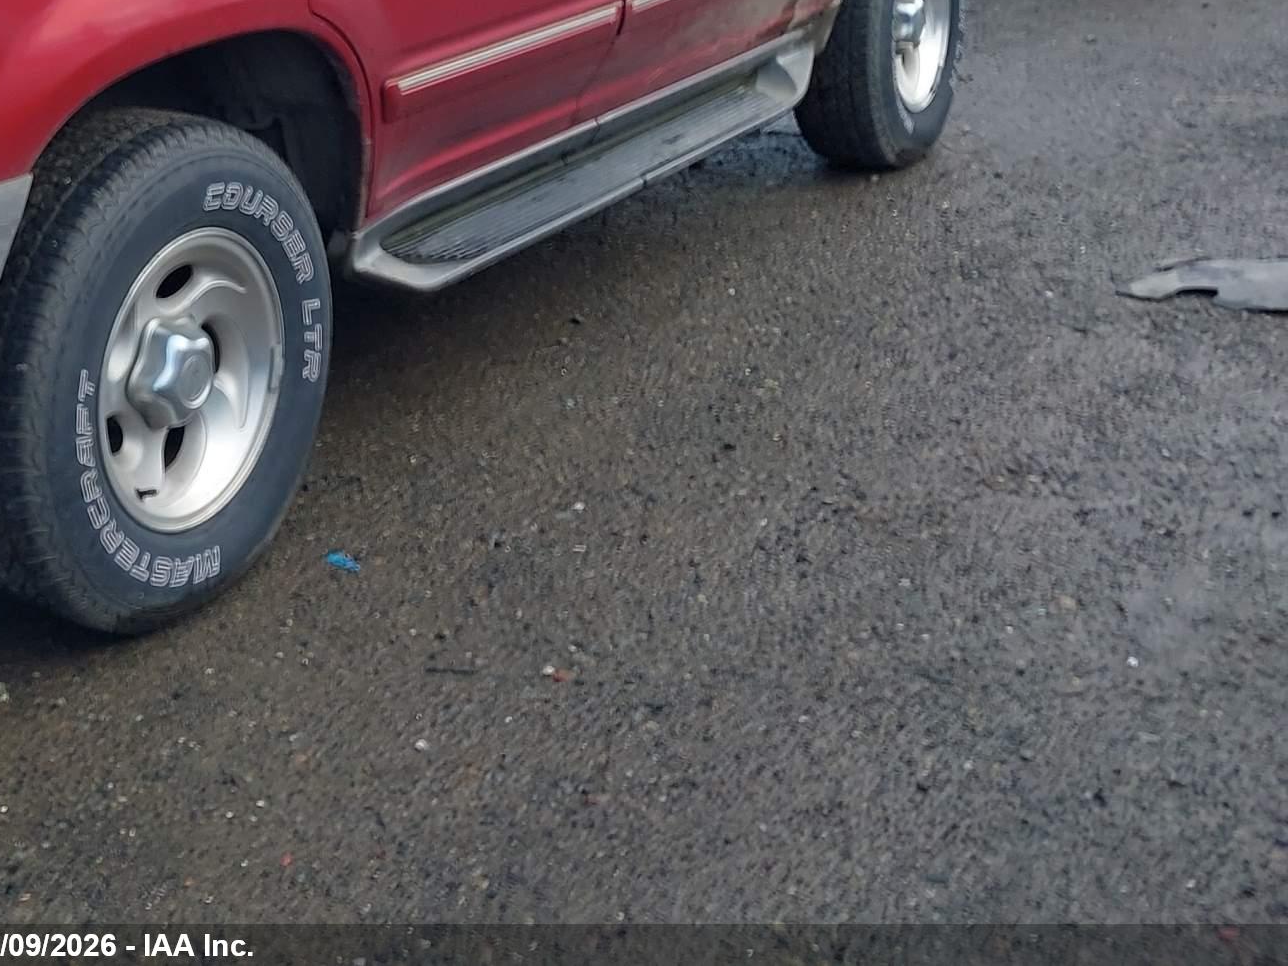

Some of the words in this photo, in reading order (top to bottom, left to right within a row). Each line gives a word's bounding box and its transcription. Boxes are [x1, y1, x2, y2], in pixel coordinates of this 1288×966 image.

[202, 181, 315, 284] COURSER
[301, 297, 323, 383] LTR
[75, 369, 221, 588] MASTERCRAFT
